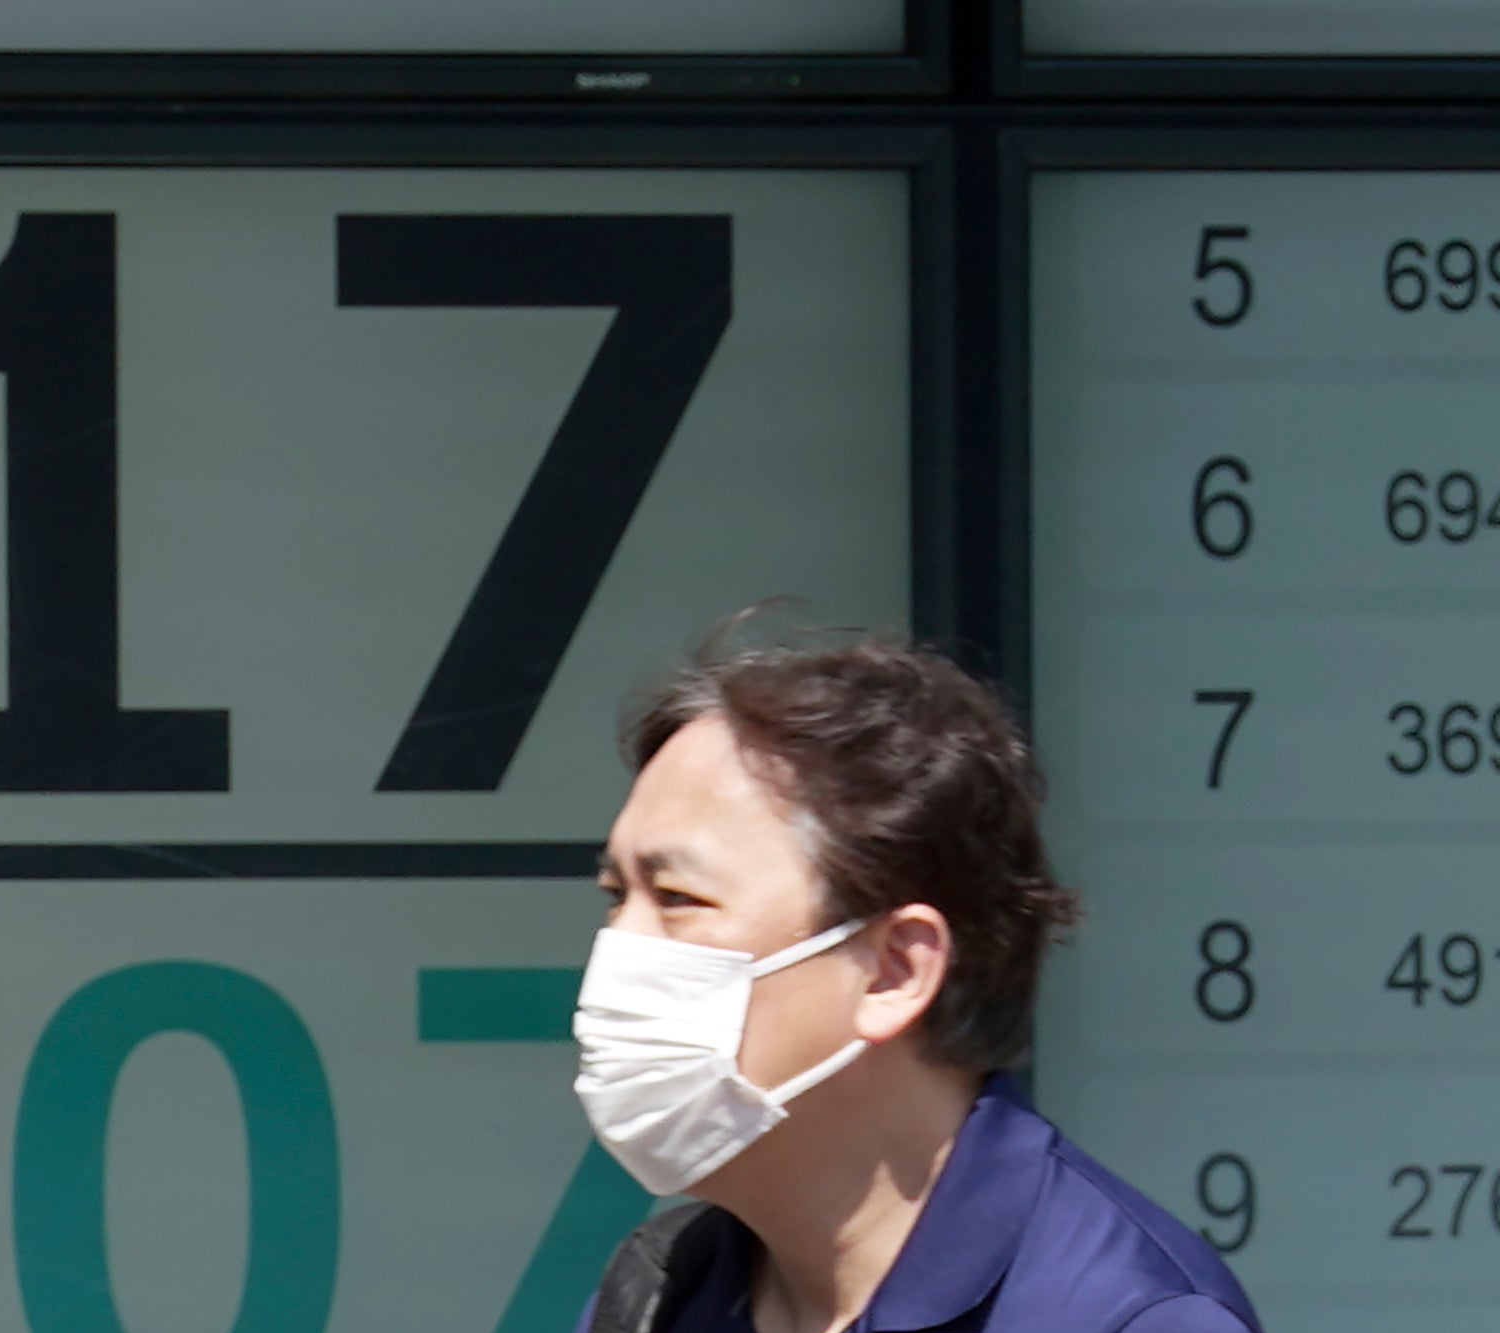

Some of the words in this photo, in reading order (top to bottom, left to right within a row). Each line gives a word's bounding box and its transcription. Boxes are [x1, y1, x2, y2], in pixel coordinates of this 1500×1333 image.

[1193, 224, 1253, 328] 5
[1193, 456, 1253, 560] 6
[1194, 690, 1254, 789] 7
[1387, 703, 1500, 775] 36
[1196, 920, 1255, 1022] 8
[1386, 933, 1500, 1006] 49
[1199, 1153, 1255, 1254] 9
[1391, 1165, 1500, 1238] 27
